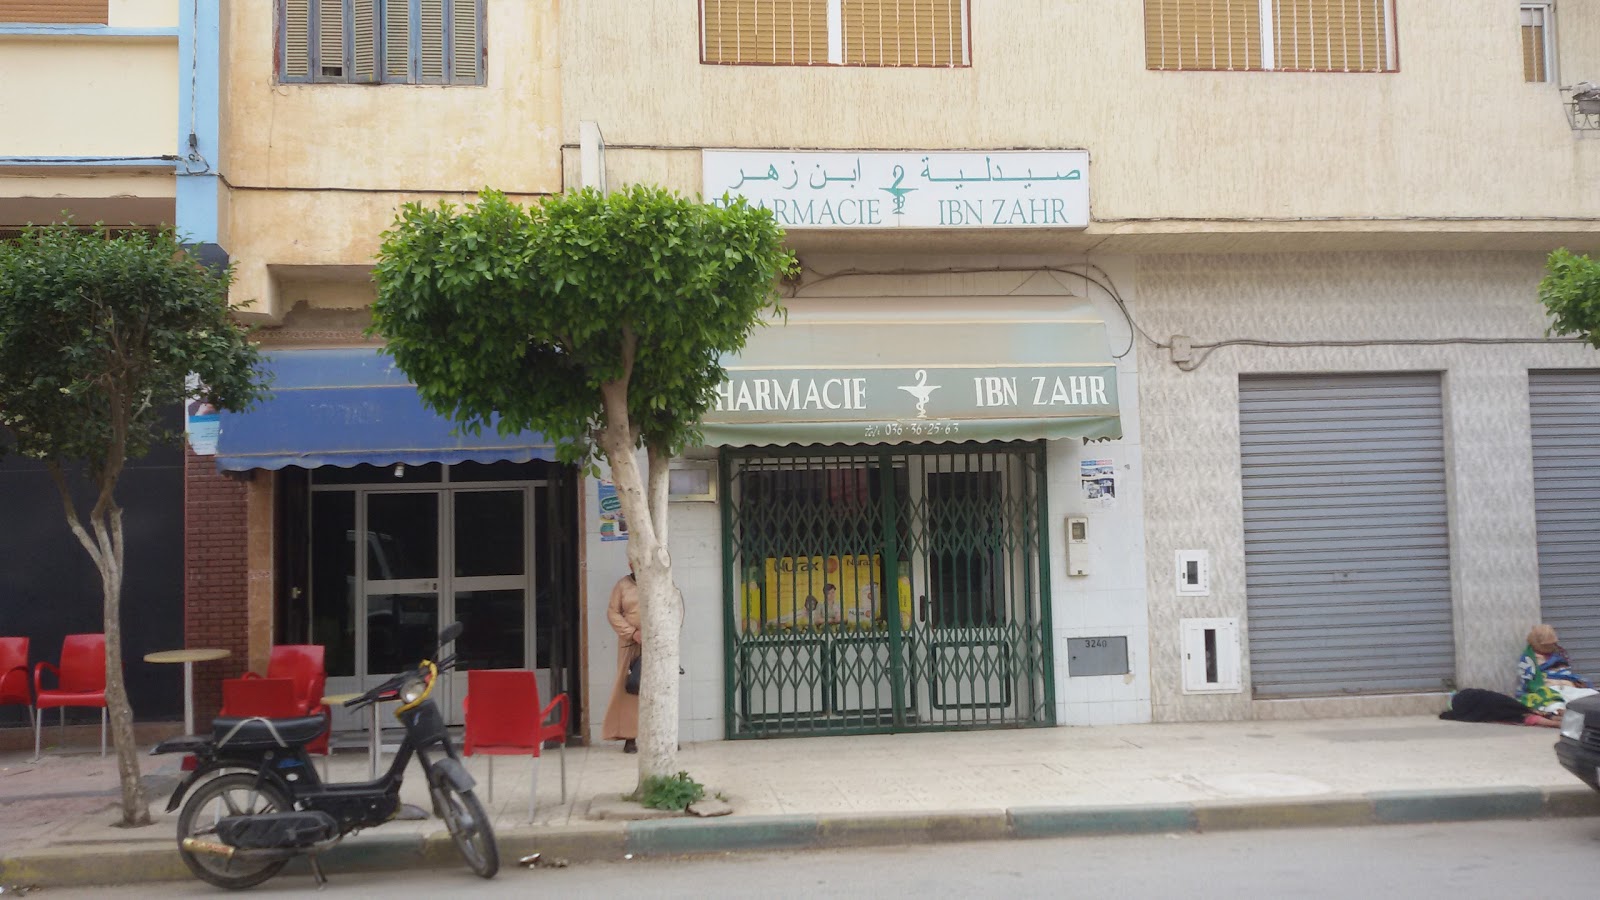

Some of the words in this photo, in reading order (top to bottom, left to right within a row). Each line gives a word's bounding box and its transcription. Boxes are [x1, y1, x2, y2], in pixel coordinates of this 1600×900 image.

[728, 160, 799, 190] زهر
[809, 156, 861, 190] ابن
[920, 156, 1081, 190] صيدلية
[938, 199, 983, 226] IBN
[992, 198, 1069, 225] ZAHR
[702, 377, 867, 411] HARMACIE
[974, 376, 1018, 407] IBN
[1031, 375, 1110, 406] ZAHR
